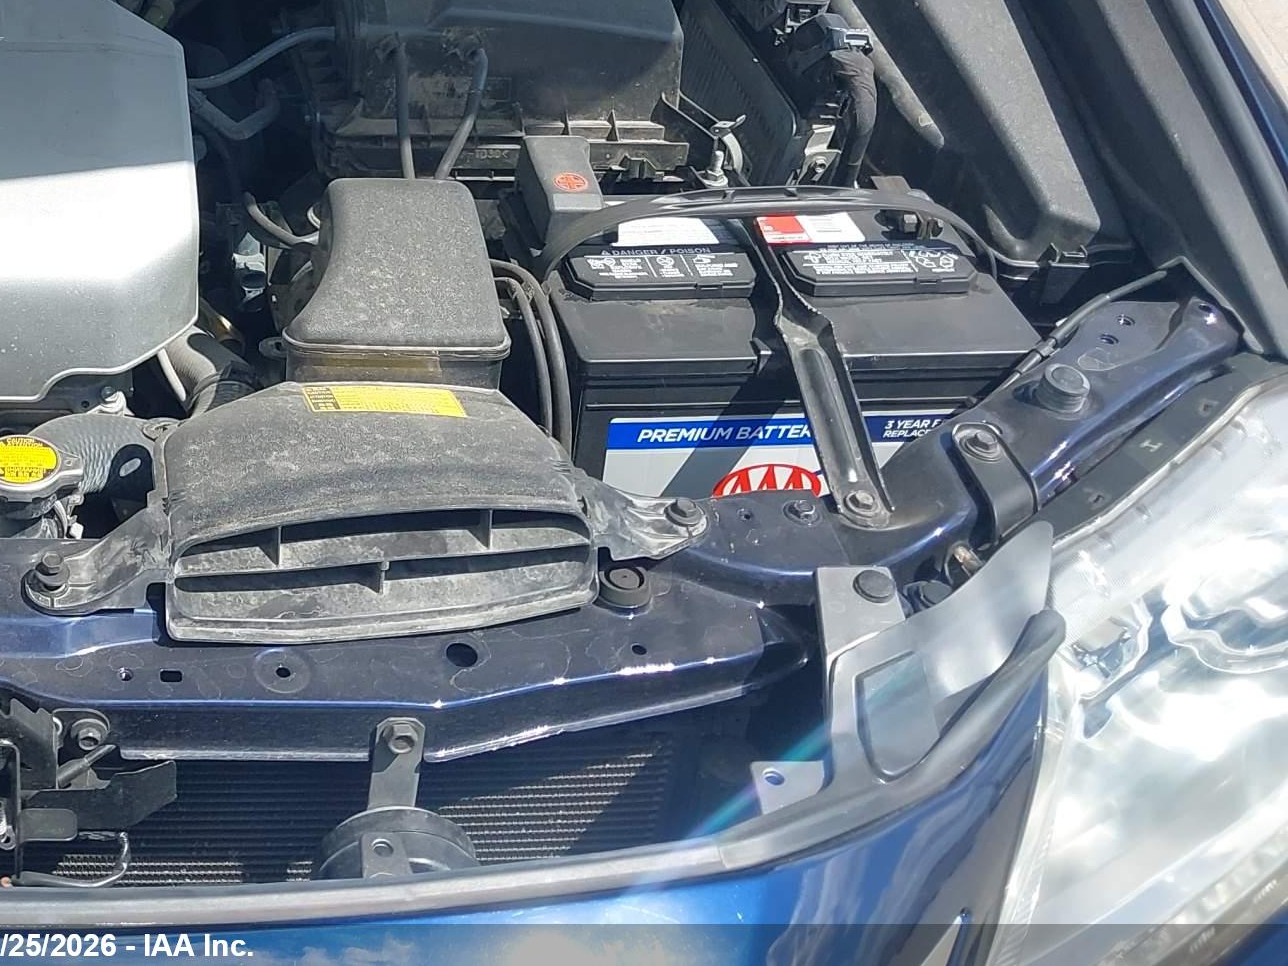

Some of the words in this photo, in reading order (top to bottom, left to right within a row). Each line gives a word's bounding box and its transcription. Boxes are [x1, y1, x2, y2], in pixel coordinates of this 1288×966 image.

[884, 420, 895, 430] 3
[897, 419, 931, 429] YEAR
[637, 426, 734, 443] PREMIUM
